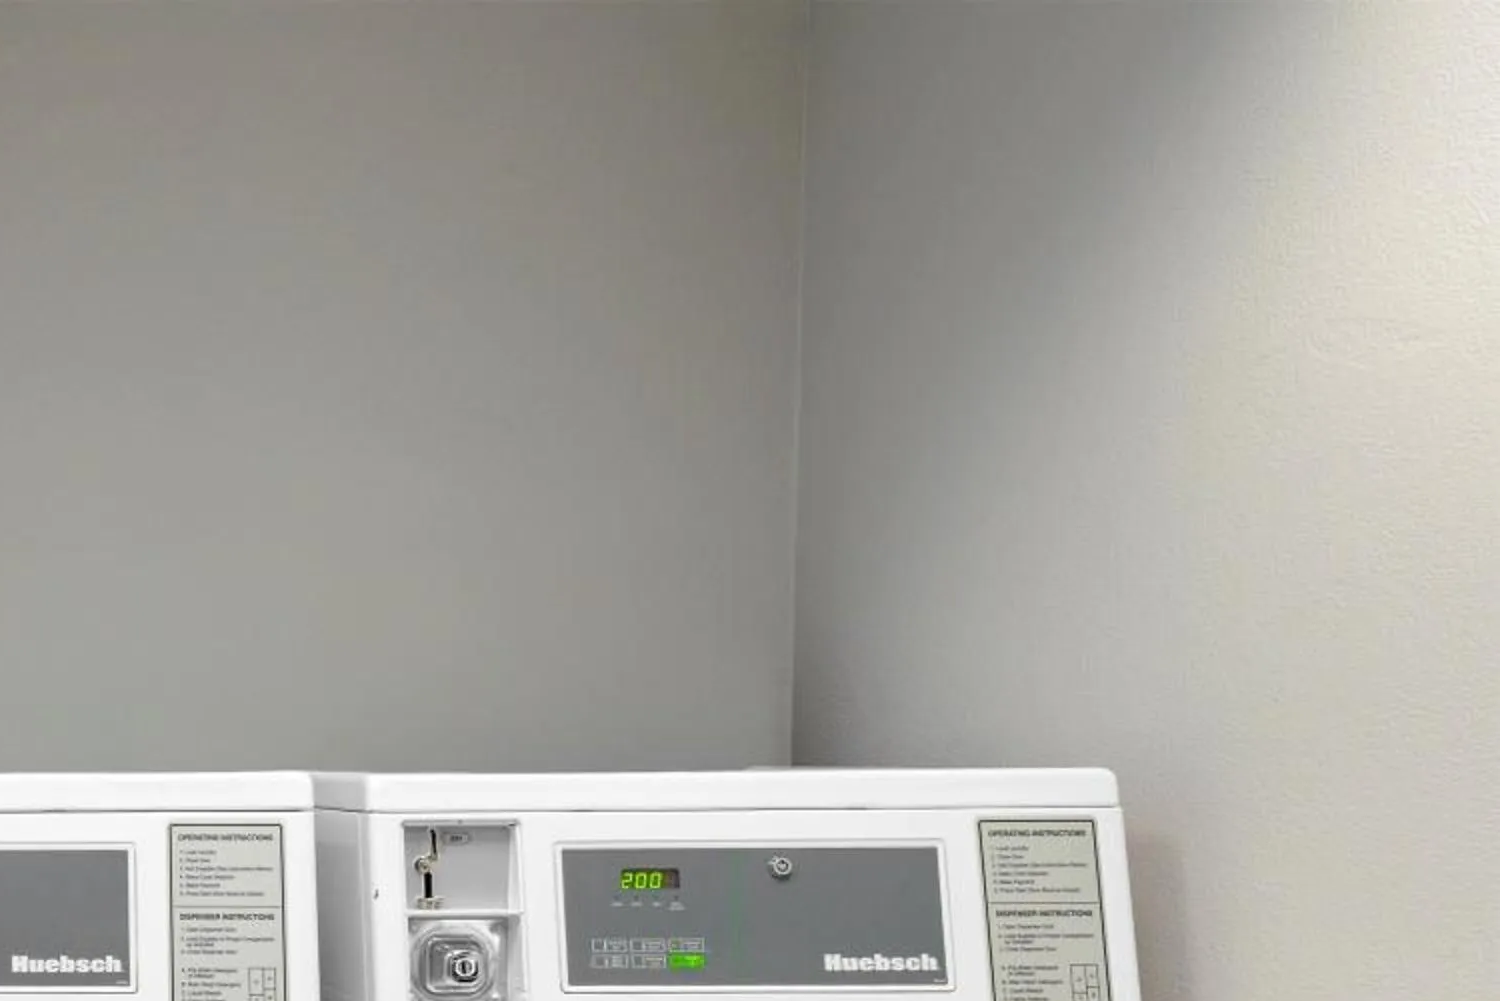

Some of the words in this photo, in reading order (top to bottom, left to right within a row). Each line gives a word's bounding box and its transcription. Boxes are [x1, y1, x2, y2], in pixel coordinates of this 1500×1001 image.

[621, 872, 662, 889] 200
[11, 955, 123, 973] Huebsch
[823, 953, 938, 971] Huebsch
